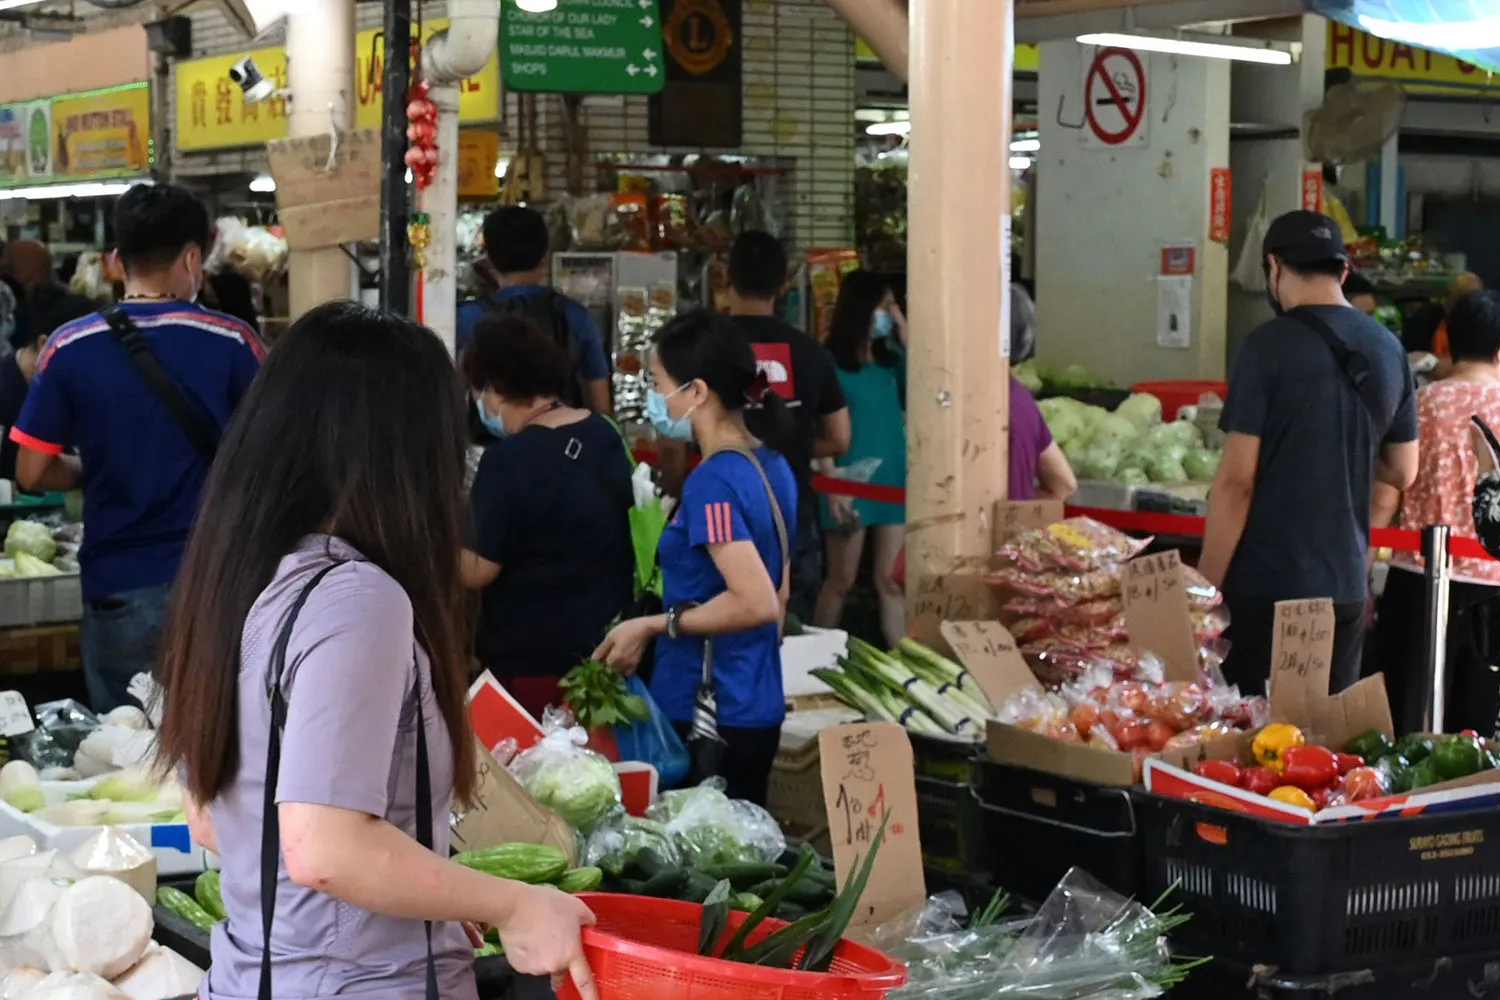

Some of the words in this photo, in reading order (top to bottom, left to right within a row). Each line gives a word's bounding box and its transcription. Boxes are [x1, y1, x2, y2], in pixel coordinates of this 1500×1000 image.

[567, 13, 590, 25] OUR
[592, 14, 618, 26] LADY
[508, 24, 535, 37] STAR
[536, 25, 549, 38] OF
[552, 26, 572, 39] THE
[574, 27, 596, 40] SEA
[511, 62, 547, 75] SHOPS
